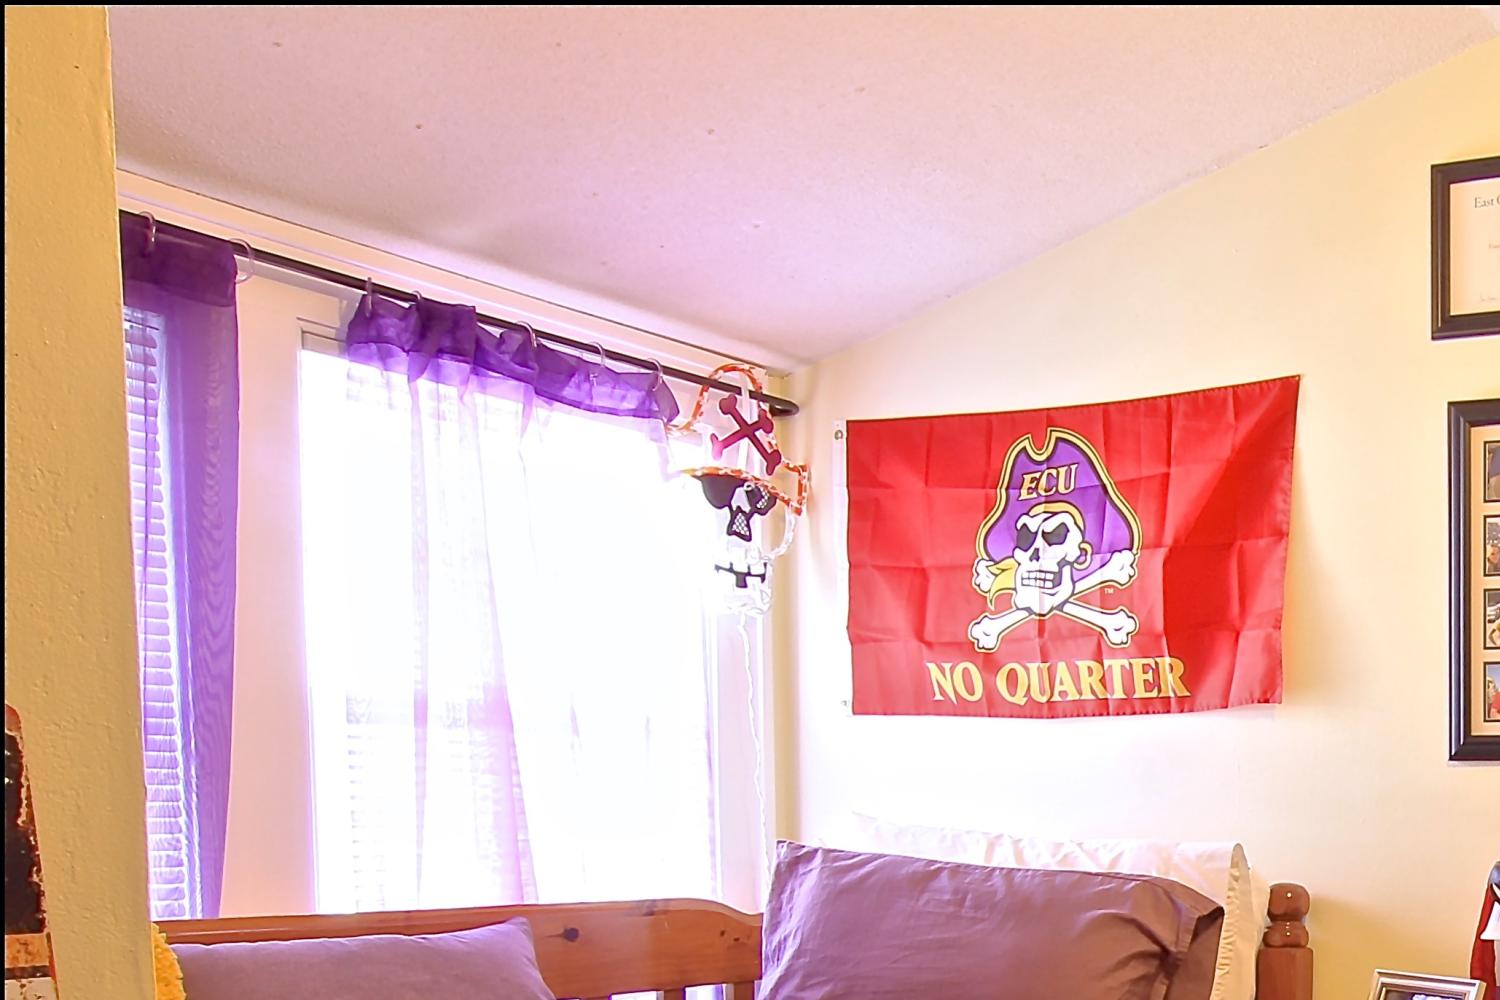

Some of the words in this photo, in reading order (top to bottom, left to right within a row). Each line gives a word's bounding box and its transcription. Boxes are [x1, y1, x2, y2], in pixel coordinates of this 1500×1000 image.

[1474, 196, 1494, 209] East
[1017, 463, 1079, 502] ECU
[926, 660, 983, 706] NO
[996, 656, 1192, 707] QUARTER
